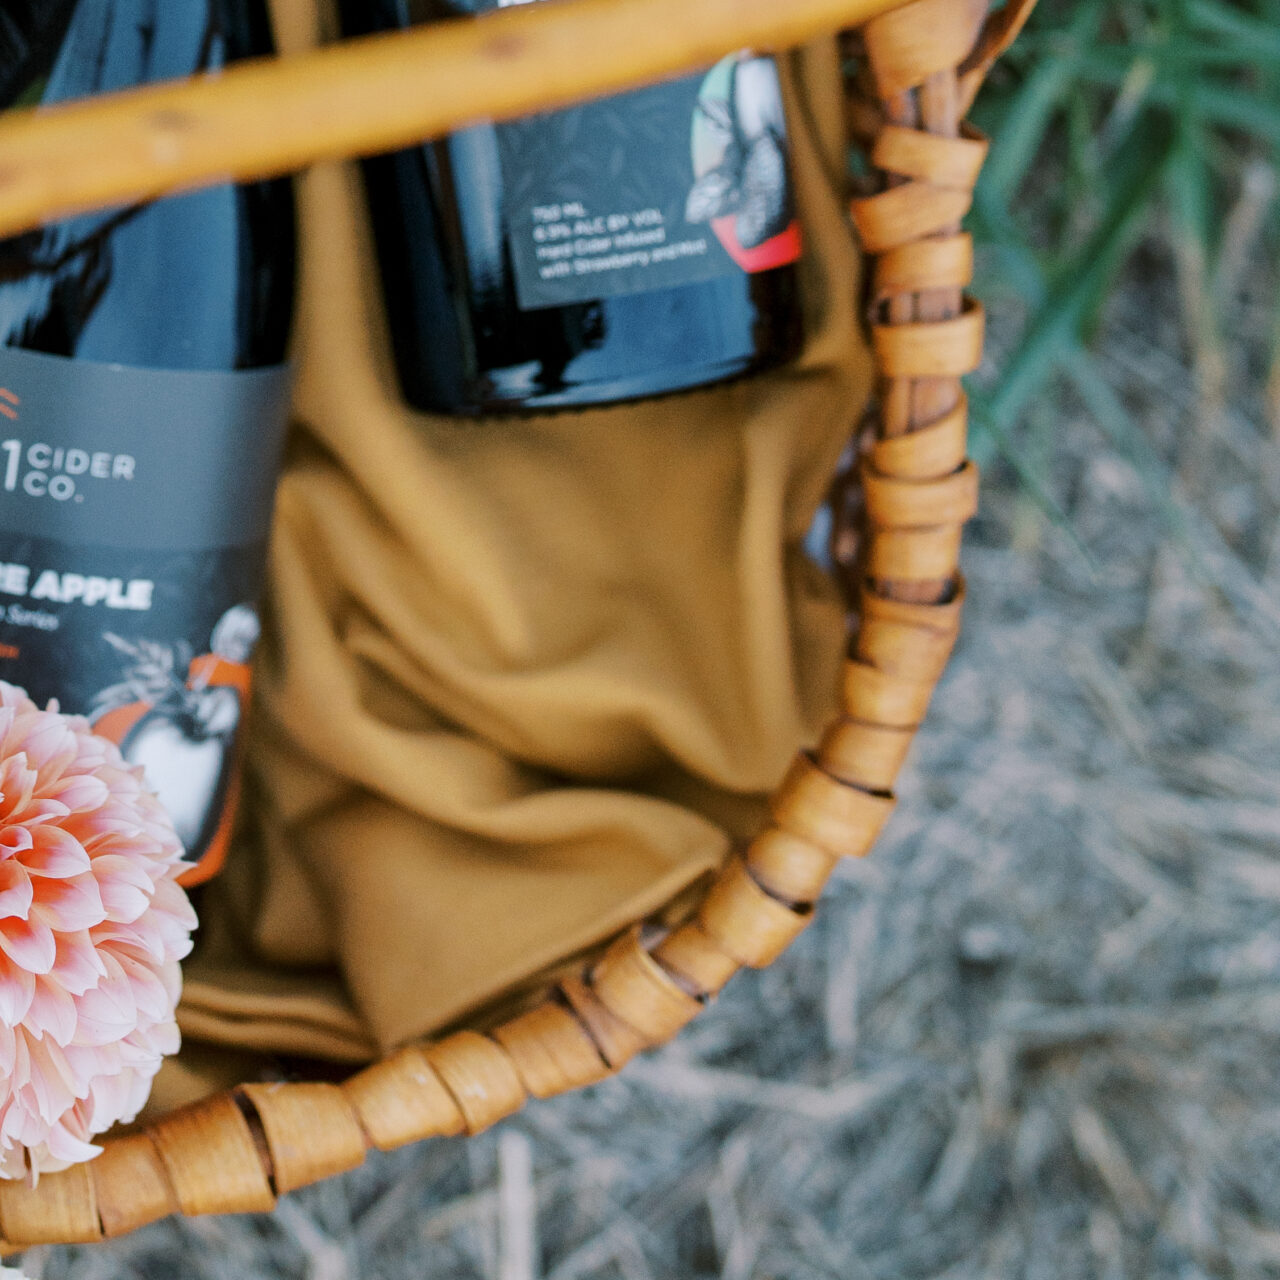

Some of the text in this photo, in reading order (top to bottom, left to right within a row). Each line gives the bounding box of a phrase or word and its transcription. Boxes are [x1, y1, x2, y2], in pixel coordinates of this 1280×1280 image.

[27, 442, 136, 481] CIDER
[23, 470, 84, 503] CO.
[30, 569, 154, 611] APPLE
